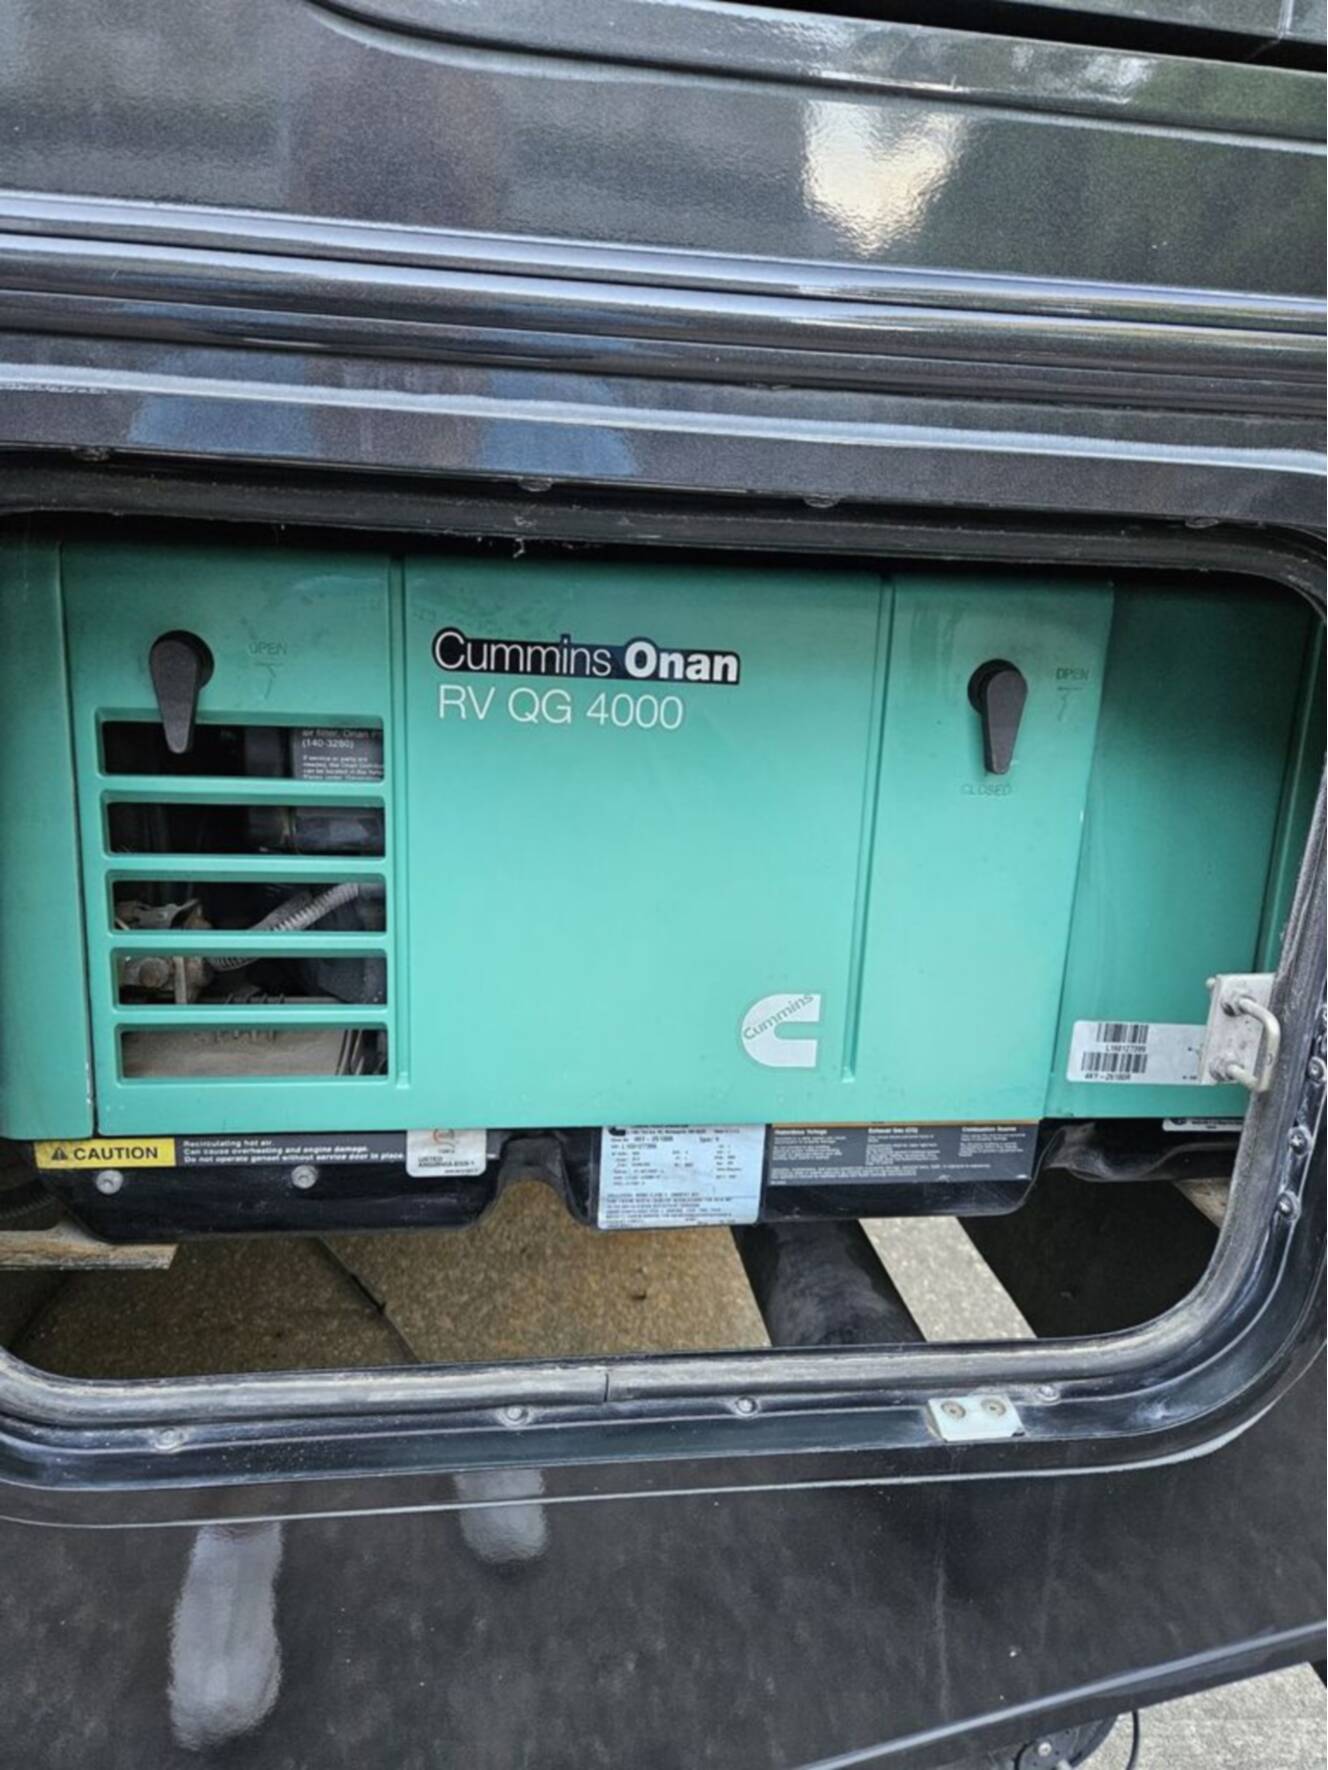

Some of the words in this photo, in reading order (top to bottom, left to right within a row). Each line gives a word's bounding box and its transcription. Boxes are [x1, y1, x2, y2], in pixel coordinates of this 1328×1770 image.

[249, 641, 287, 655] OPEN
[434, 631, 612, 677] Cummins
[624, 640, 738, 682] Onan
[1056, 667, 1089, 681] OPEN
[438, 684, 495, 720] RV
[507, 687, 573, 724] QG
[586, 691, 684, 729] 4000
[960, 784, 1012, 796] CLOSED
[743, 994, 814, 1040] Cummins
[73, 1147, 158, 1160] CAUTION
